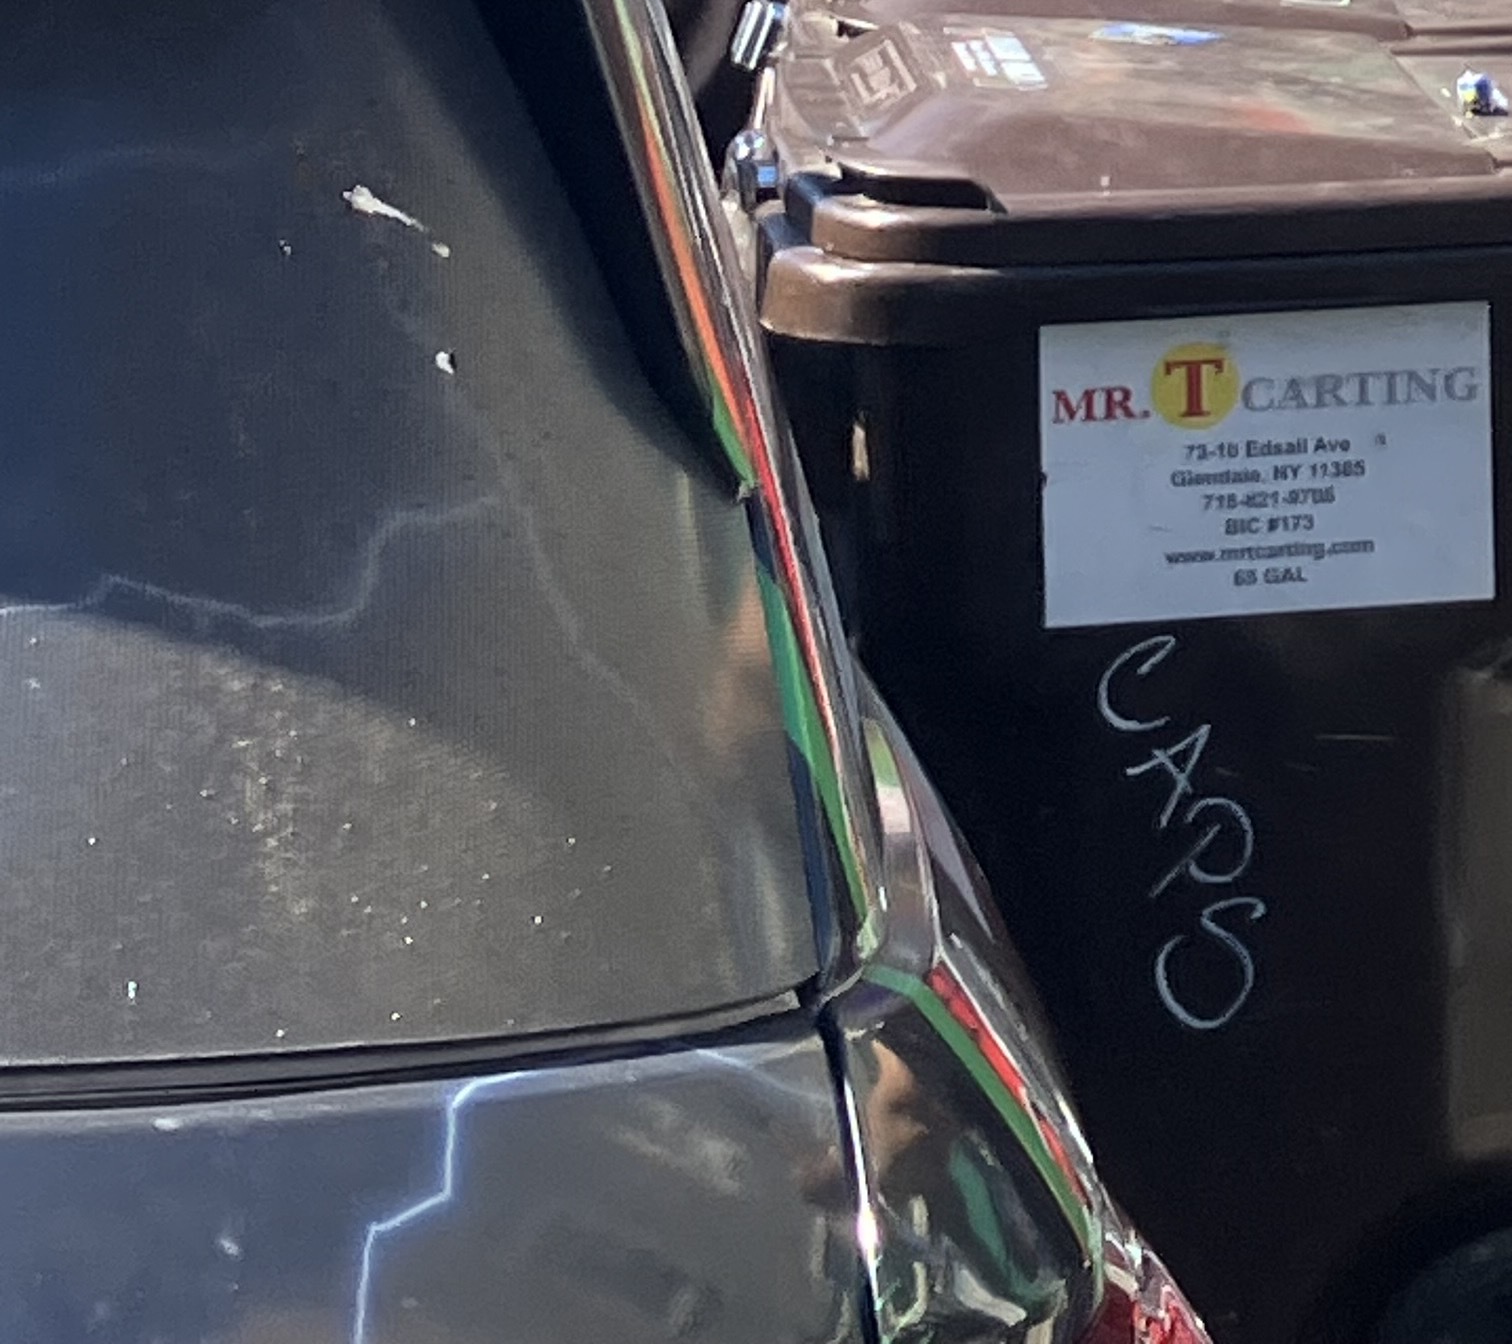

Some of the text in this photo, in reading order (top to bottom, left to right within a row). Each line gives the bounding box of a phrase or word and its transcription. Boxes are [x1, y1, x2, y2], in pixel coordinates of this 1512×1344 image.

[1050, 357, 1479, 425] MR. T CARTING
[1312, 436, 1351, 454] Ave
[1272, 464, 1302, 482] NY
[1262, 566, 1309, 585] GAL
